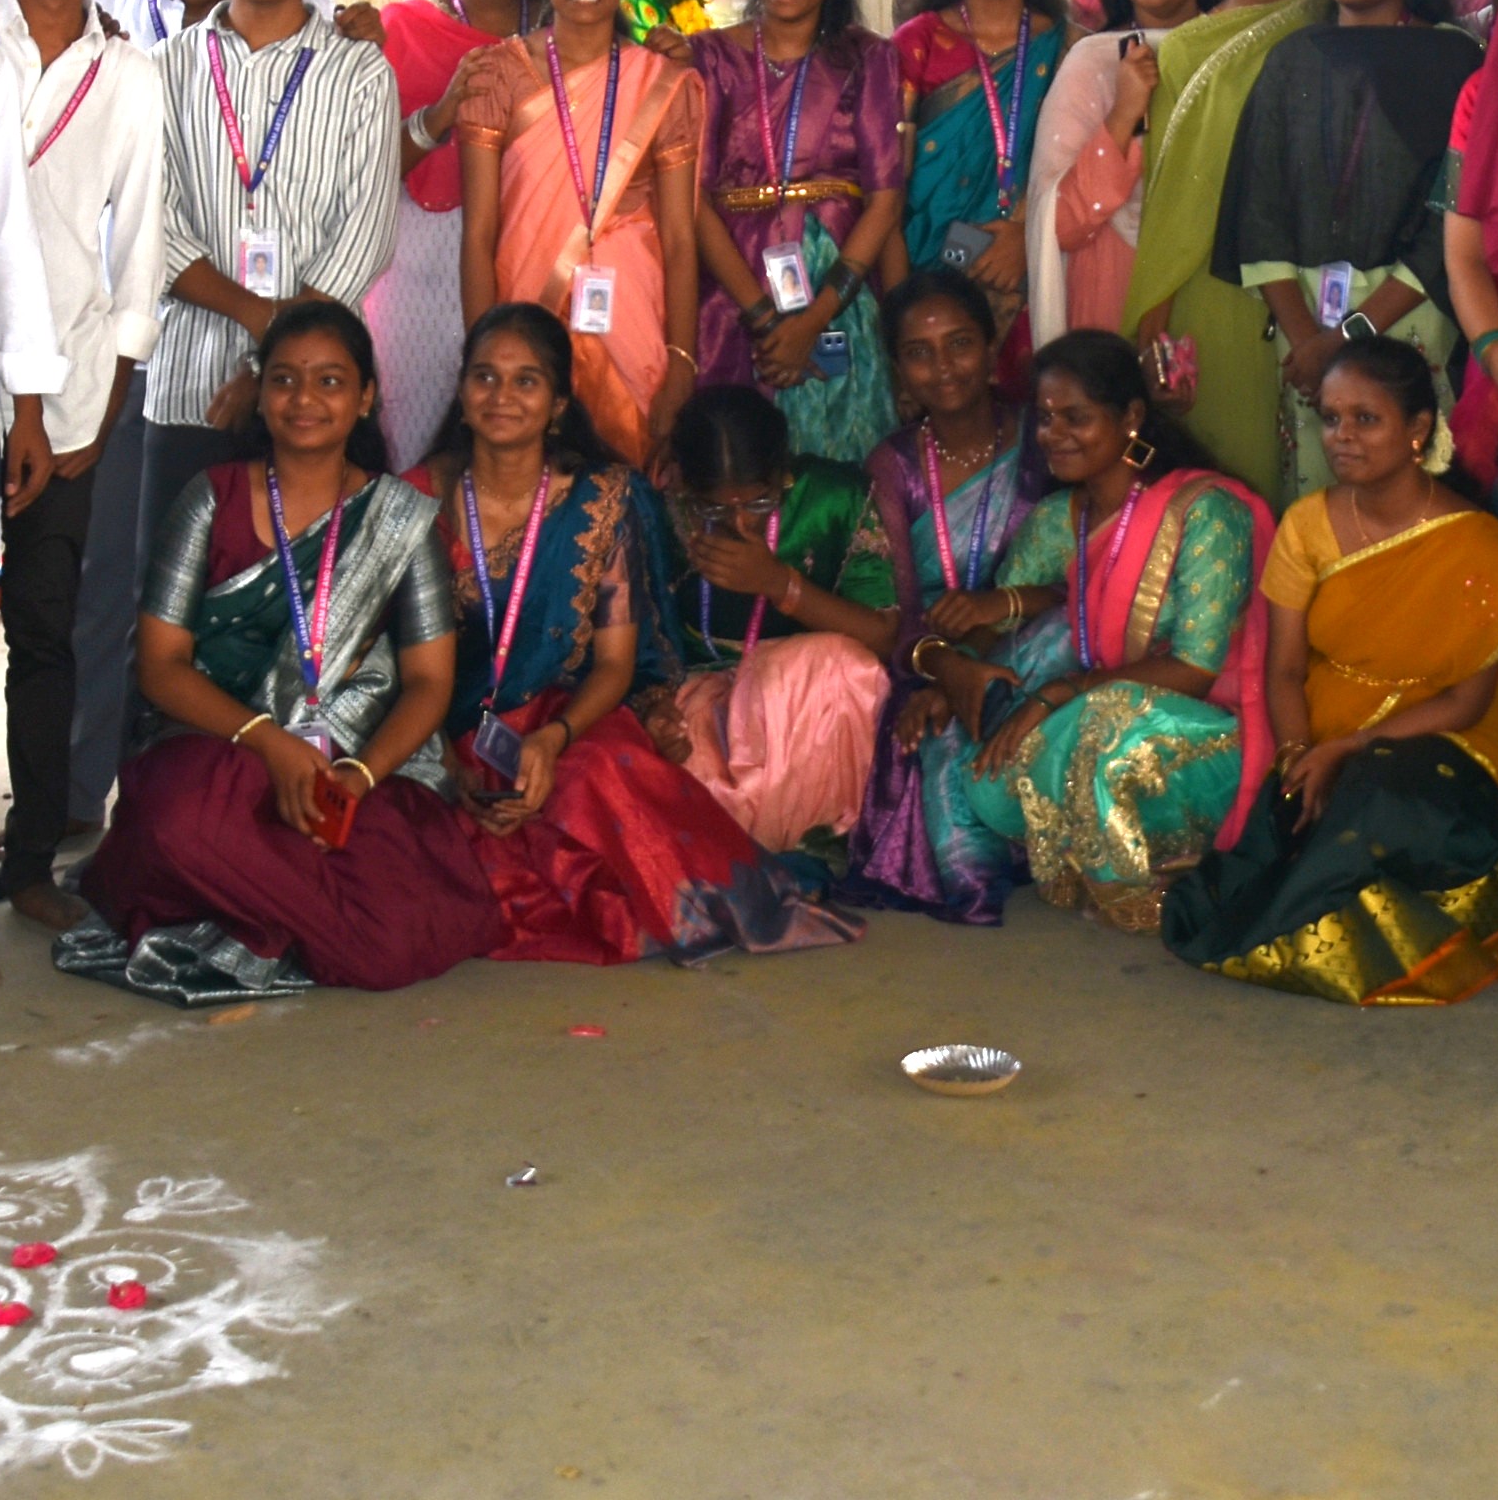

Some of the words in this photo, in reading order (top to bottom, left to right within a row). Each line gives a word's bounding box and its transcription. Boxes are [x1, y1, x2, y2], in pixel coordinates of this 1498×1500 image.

[211, 64, 224, 92] SCIENCE
[217, 91, 229, 108] AND
[986, 93, 996, 109] AND
[1010, 97, 1018, 113] AND
[55, 111, 70, 130] ARTS
[65, 97, 79, 114] AND
[221, 106, 234, 126] ARTS
[262, 131, 278, 160] JAIRAM
[271, 112, 285, 133] ARTS
[278, 96, 290, 114] AND
[284, 70, 302, 98] SCIENCE
[560, 102, 572, 131] SCIENCE
[789, 115, 798, 132] AND
[989, 109, 1000, 128] ARTS
[1008, 112, 1017, 131] ARTS
[565, 130, 575, 147] AND
[598, 137, 607, 153] AND
[764, 129, 773, 147] ARTS
[787, 131, 795, 150] ARTS
[1005, 130, 1015, 157] JAIRAM
[568, 146, 578, 165] ARTS
[595, 153, 605, 171] ARTS
[270, 488, 282, 513] SALEM
[465, 489, 476, 516] SALEM
[932, 501, 944, 533] SCIENCE
[1118, 499, 1133, 527] SALEM
[469, 515, 482, 549] COLLEGE
[525, 511, 540, 545] COLLEGE
[937, 532, 947, 550] AND
[970, 534, 980, 552] AND
[280, 545, 296, 577] SCIENCE
[324, 537, 337, 569] SCIENCE
[518, 544, 532, 578] SCIENCE
[940, 549, 952, 570] ARTS
[474, 548, 488, 582] SCIENCE
[288, 575, 300, 594] AND
[321, 568, 332, 587] AND
[514, 576, 525, 595] AND
[293, 593, 304, 616] ARTS
[318, 586, 329, 608] ARTS
[509, 593, 521, 616] ARTS
[297, 615, 310, 648] JAIRAM
[314, 607, 326, 639] JAIRAM
